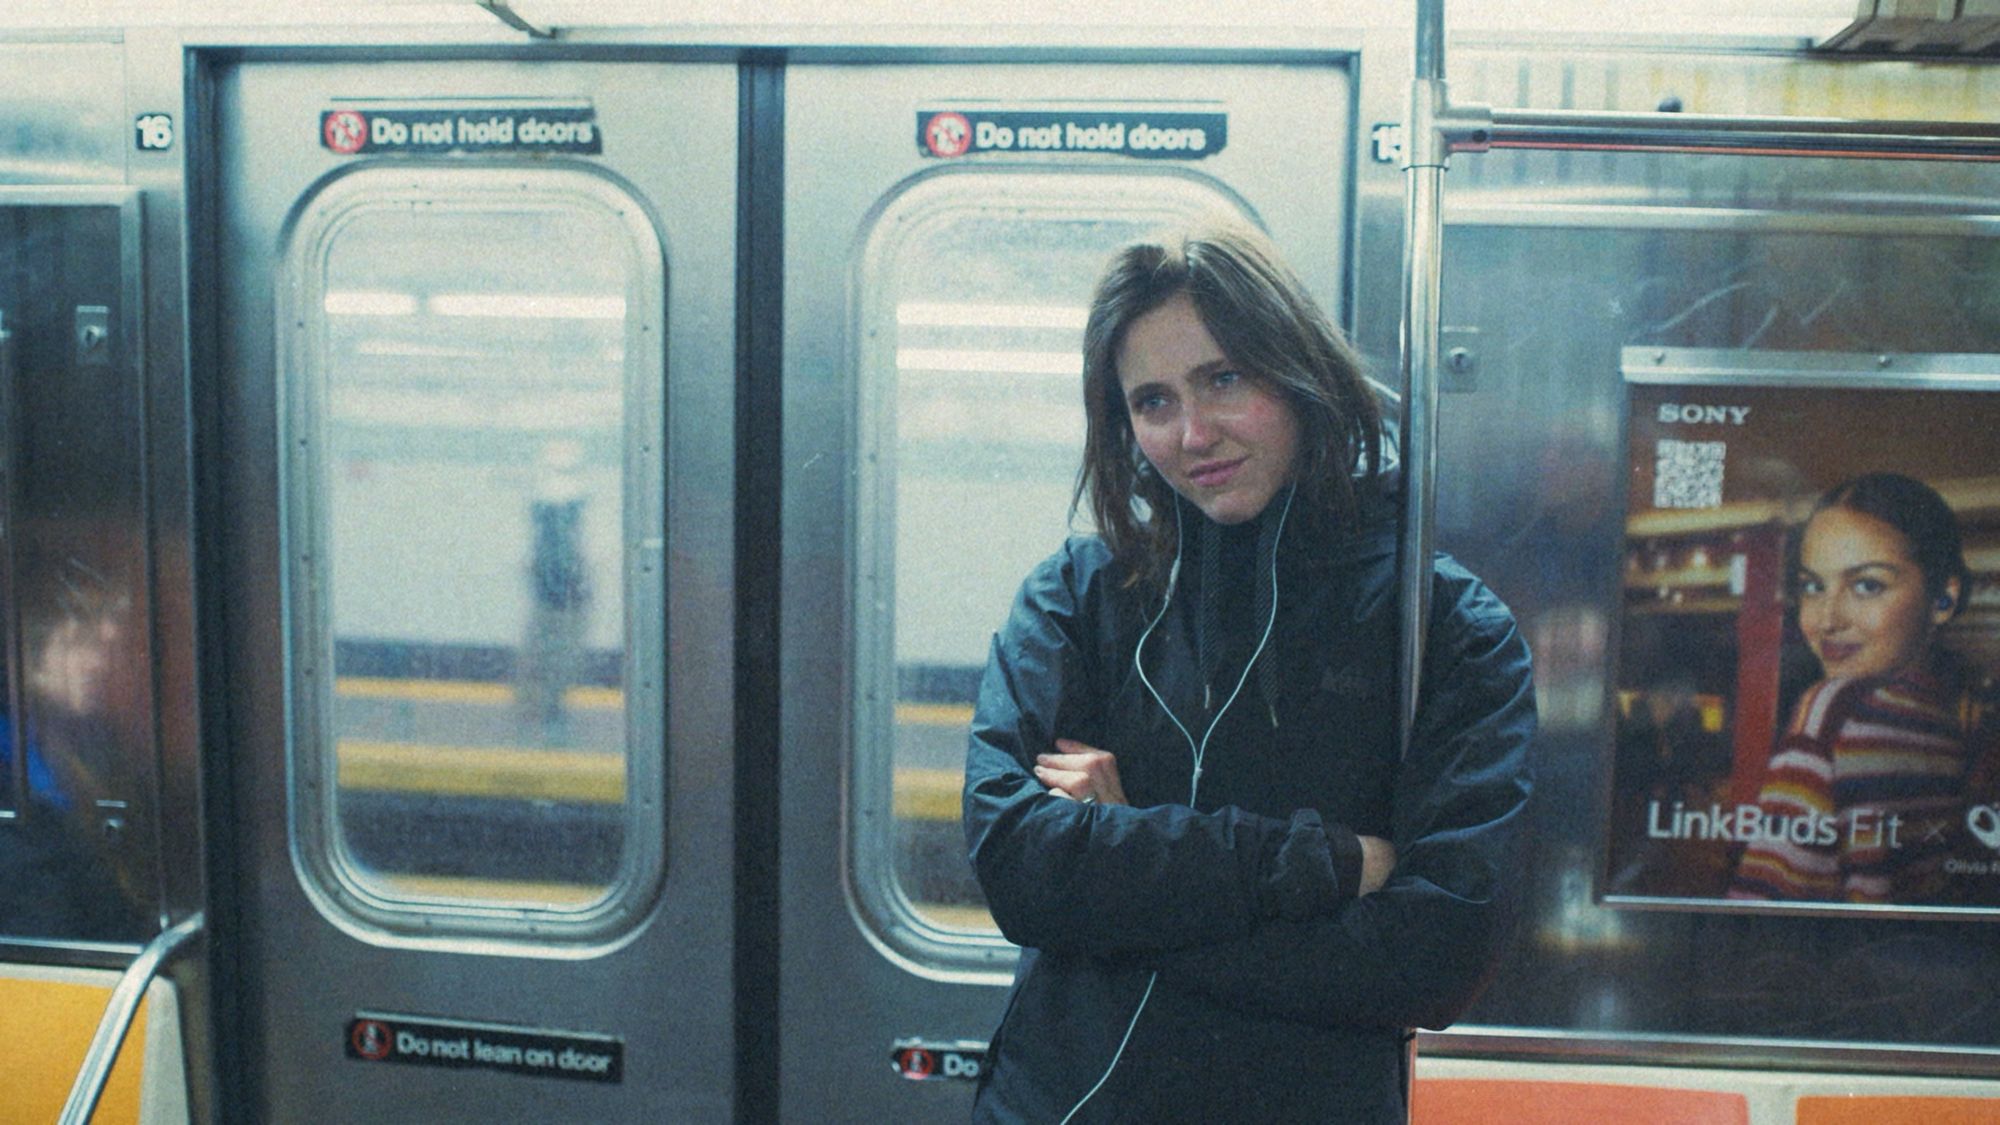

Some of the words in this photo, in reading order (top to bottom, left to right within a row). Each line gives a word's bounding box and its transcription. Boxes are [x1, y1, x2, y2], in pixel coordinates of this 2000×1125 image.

[371, 118, 408, 144] Do
[412, 119, 451, 144] not
[457, 117, 514, 144] hold
[518, 118, 593, 144] doors
[976, 121, 1014, 149] Do
[1018, 123, 1062, 149] not
[1066, 122, 1124, 149] hold
[1128, 123, 1206, 150] doors
[1659, 403, 1751, 425] SONY
[1649, 801, 1838, 845] LinkBuds
[1849, 808, 1903, 849] Fit
[396, 1031, 430, 1056] Do
[432, 1039, 469, 1060] not
[474, 1038, 522, 1064] lean
[524, 1049, 554, 1067] on
[557, 1050, 612, 1073] door
[943, 1053, 979, 1077] Do
